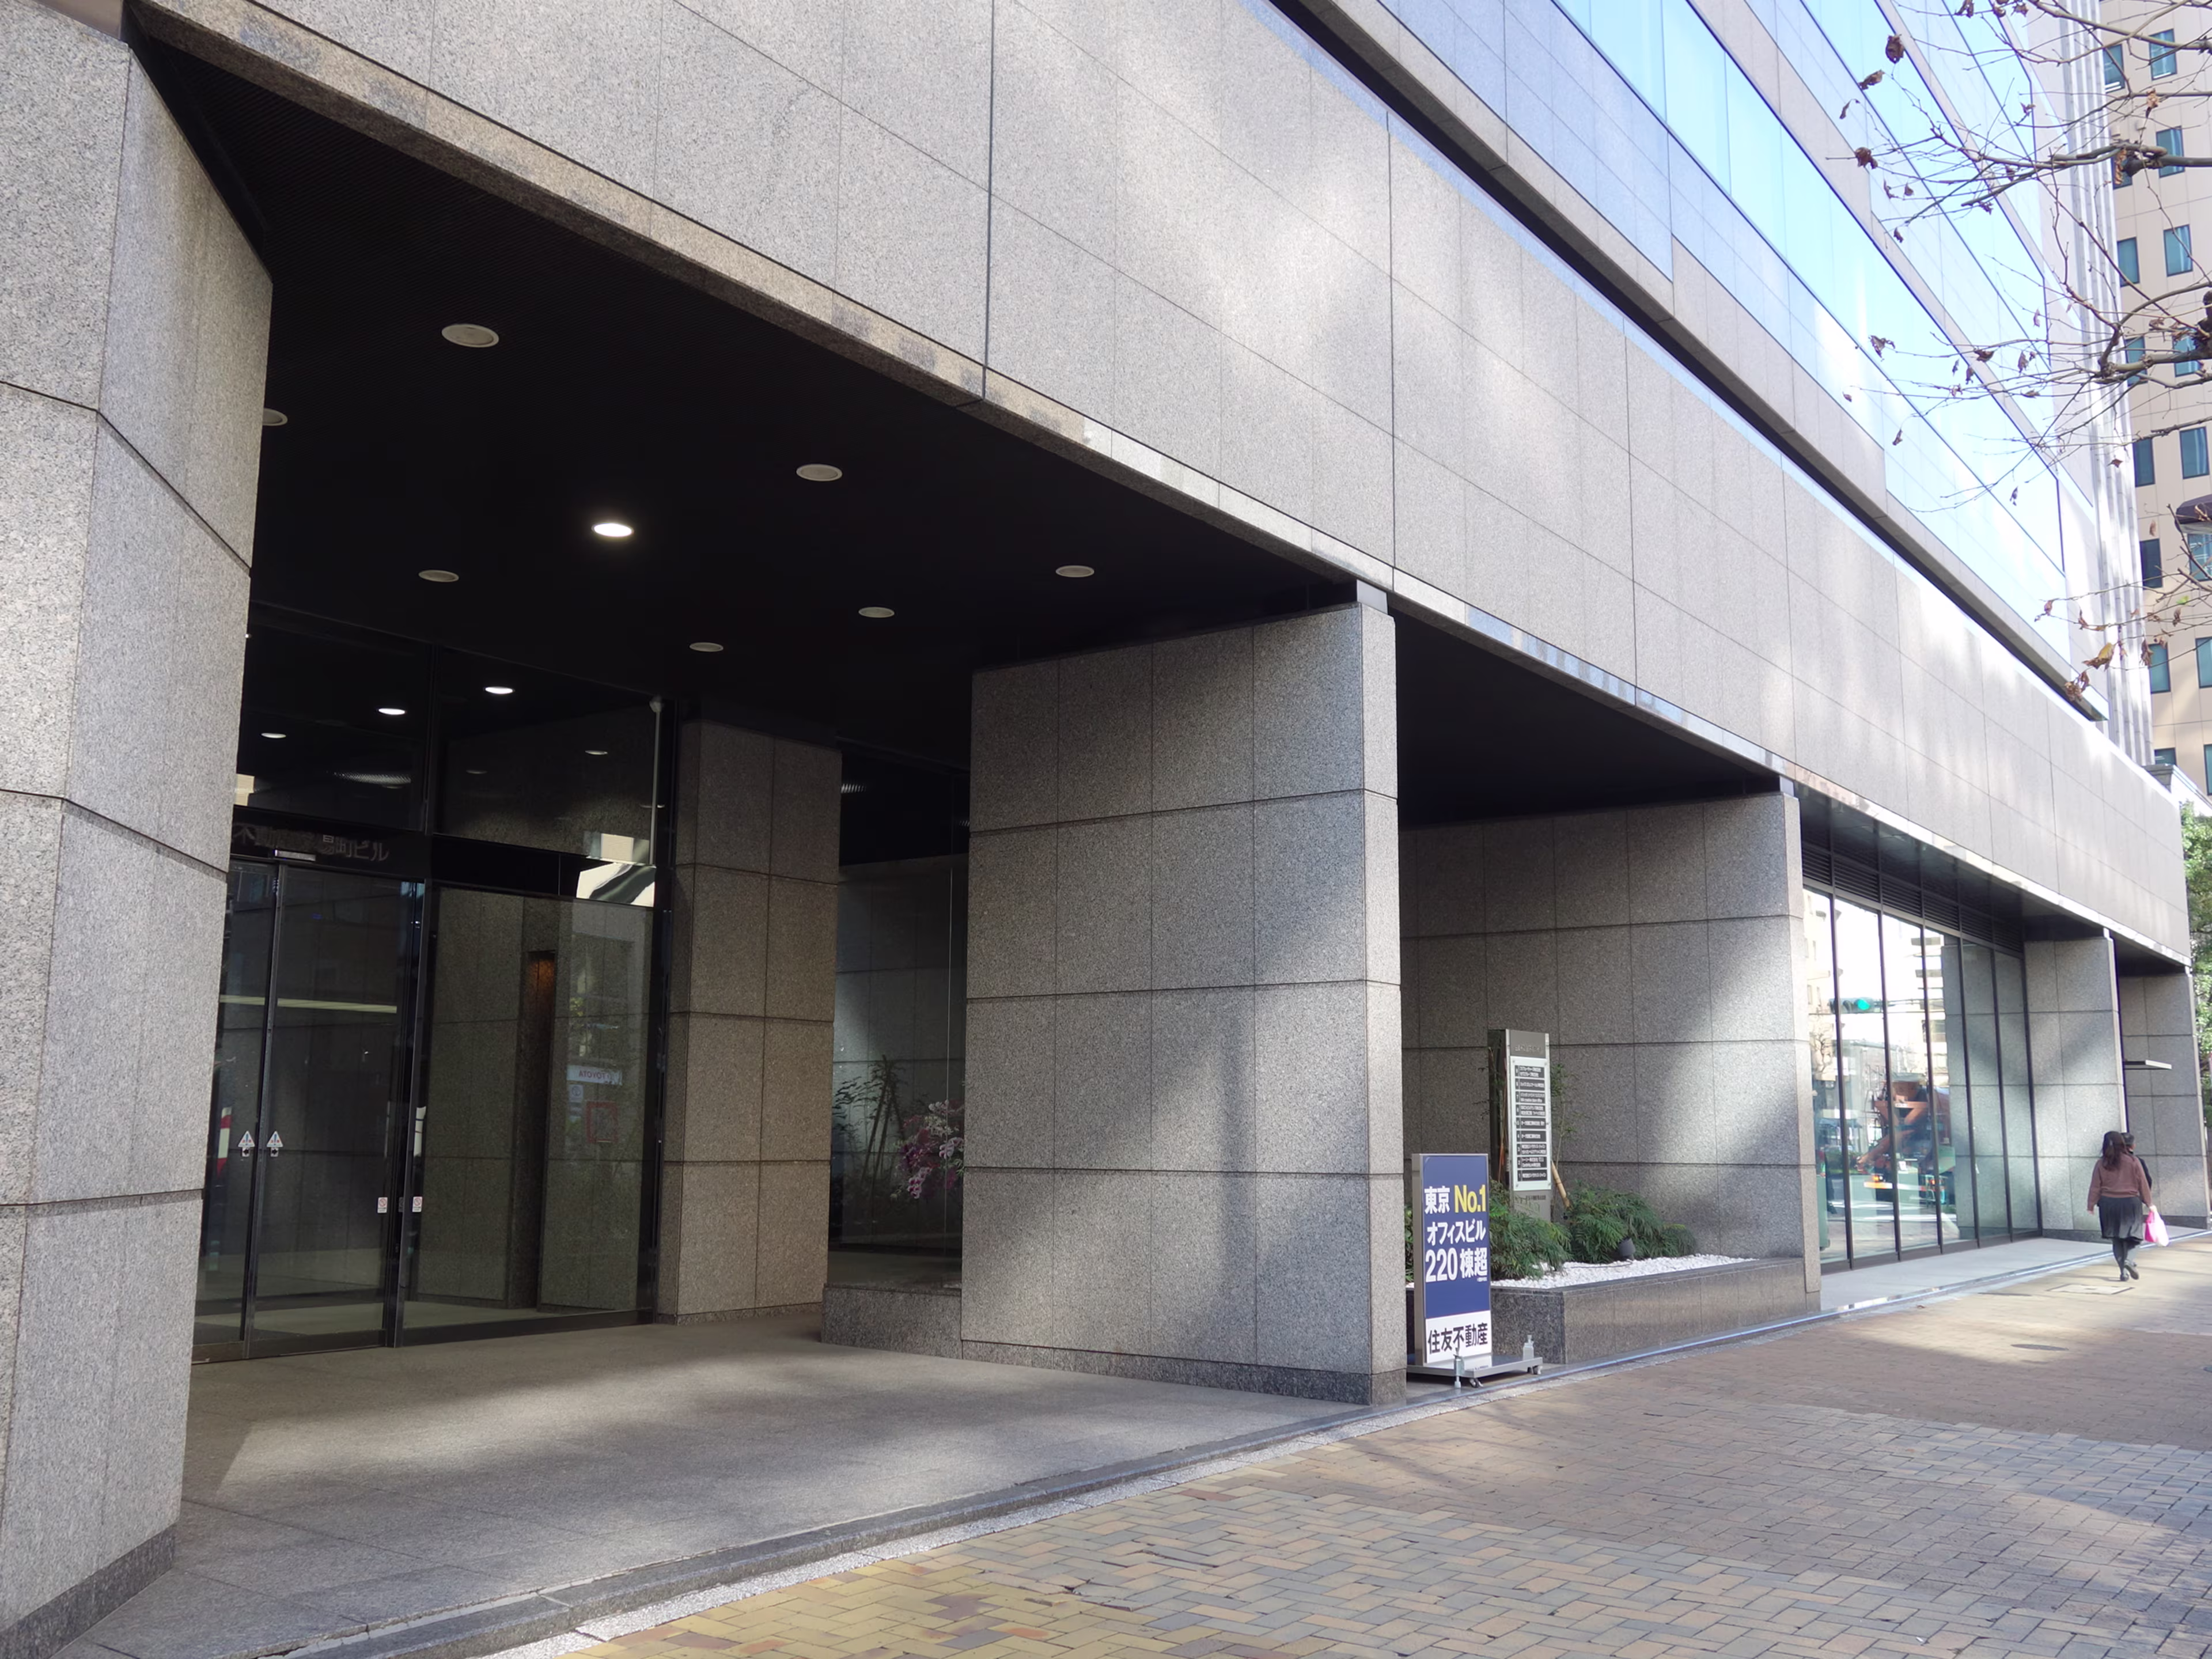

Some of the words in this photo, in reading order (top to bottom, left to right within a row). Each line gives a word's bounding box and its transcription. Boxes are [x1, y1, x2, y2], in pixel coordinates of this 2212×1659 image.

[1424, 1185, 1450, 1214] 東京
[1454, 1184, 1486, 1213] No.1
[1427, 1218, 1486, 1246] オフィスビル
[1427, 1322, 1488, 1355] 住友不動産
